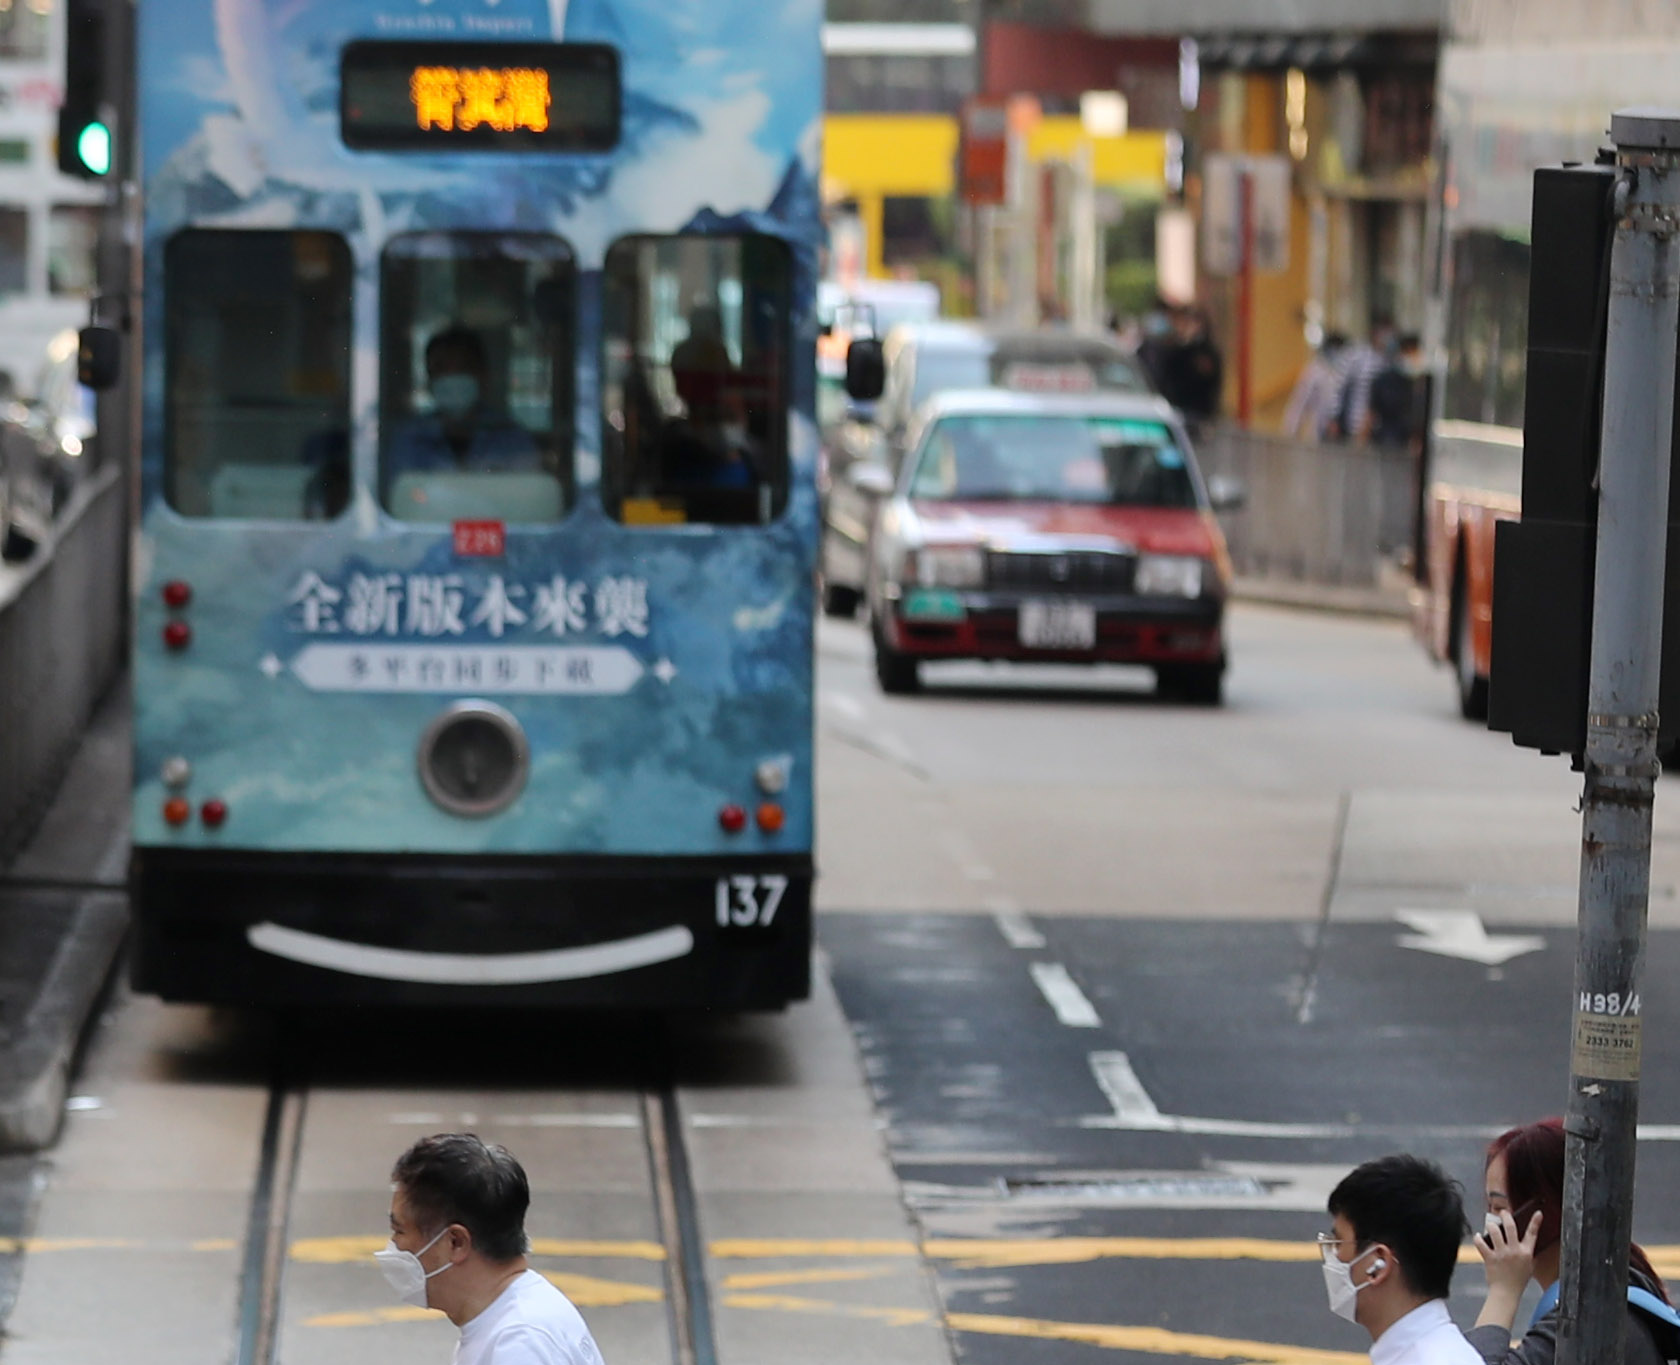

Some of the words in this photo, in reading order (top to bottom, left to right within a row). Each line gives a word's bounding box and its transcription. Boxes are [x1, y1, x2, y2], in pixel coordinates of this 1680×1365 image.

[288, 571, 650, 638] 全新版本來襲
[715, 875, 787, 928] 137
[1579, 991, 1640, 1016] H38/4
[1586, 1036, 1610, 1048] 2333
